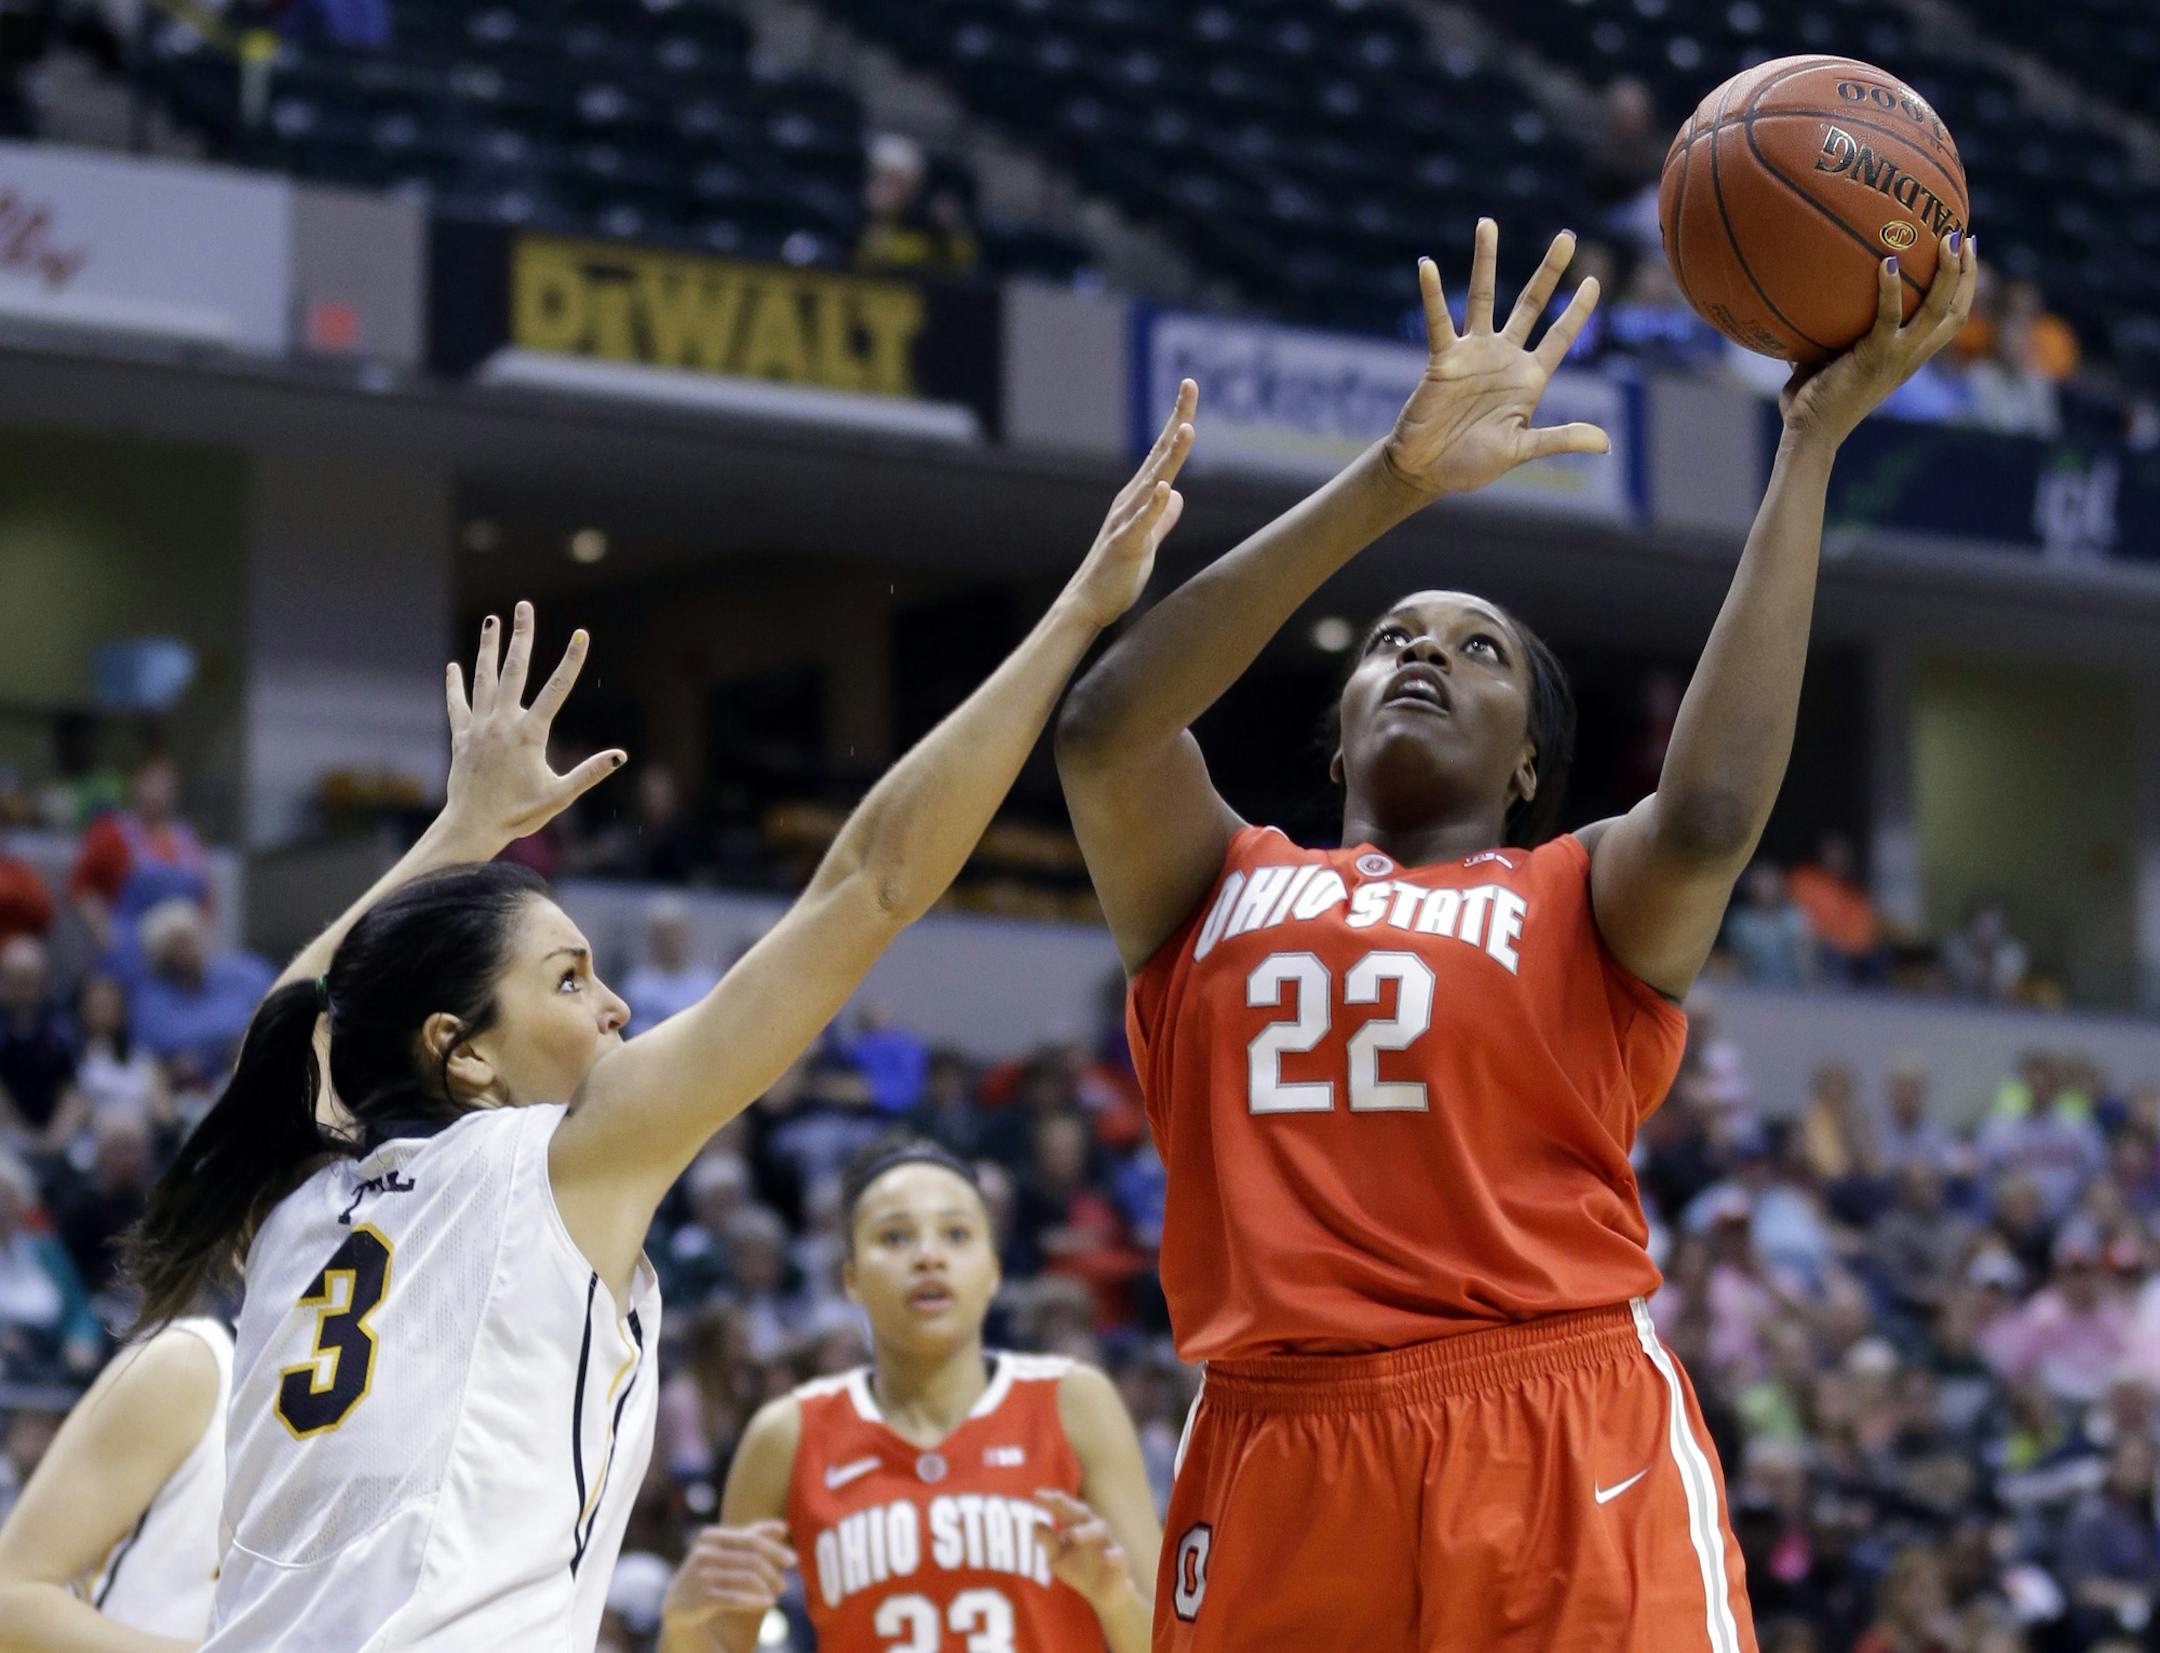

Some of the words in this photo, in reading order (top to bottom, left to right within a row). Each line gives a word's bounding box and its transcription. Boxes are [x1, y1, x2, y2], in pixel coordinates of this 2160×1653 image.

[1193, 864, 1348, 964] OHIO
[1345, 880, 1528, 976] STATE
[1246, 950, 1436, 1115] 22
[274, 1222, 395, 1441] 3
[815, 1498, 921, 1610] OHIO
